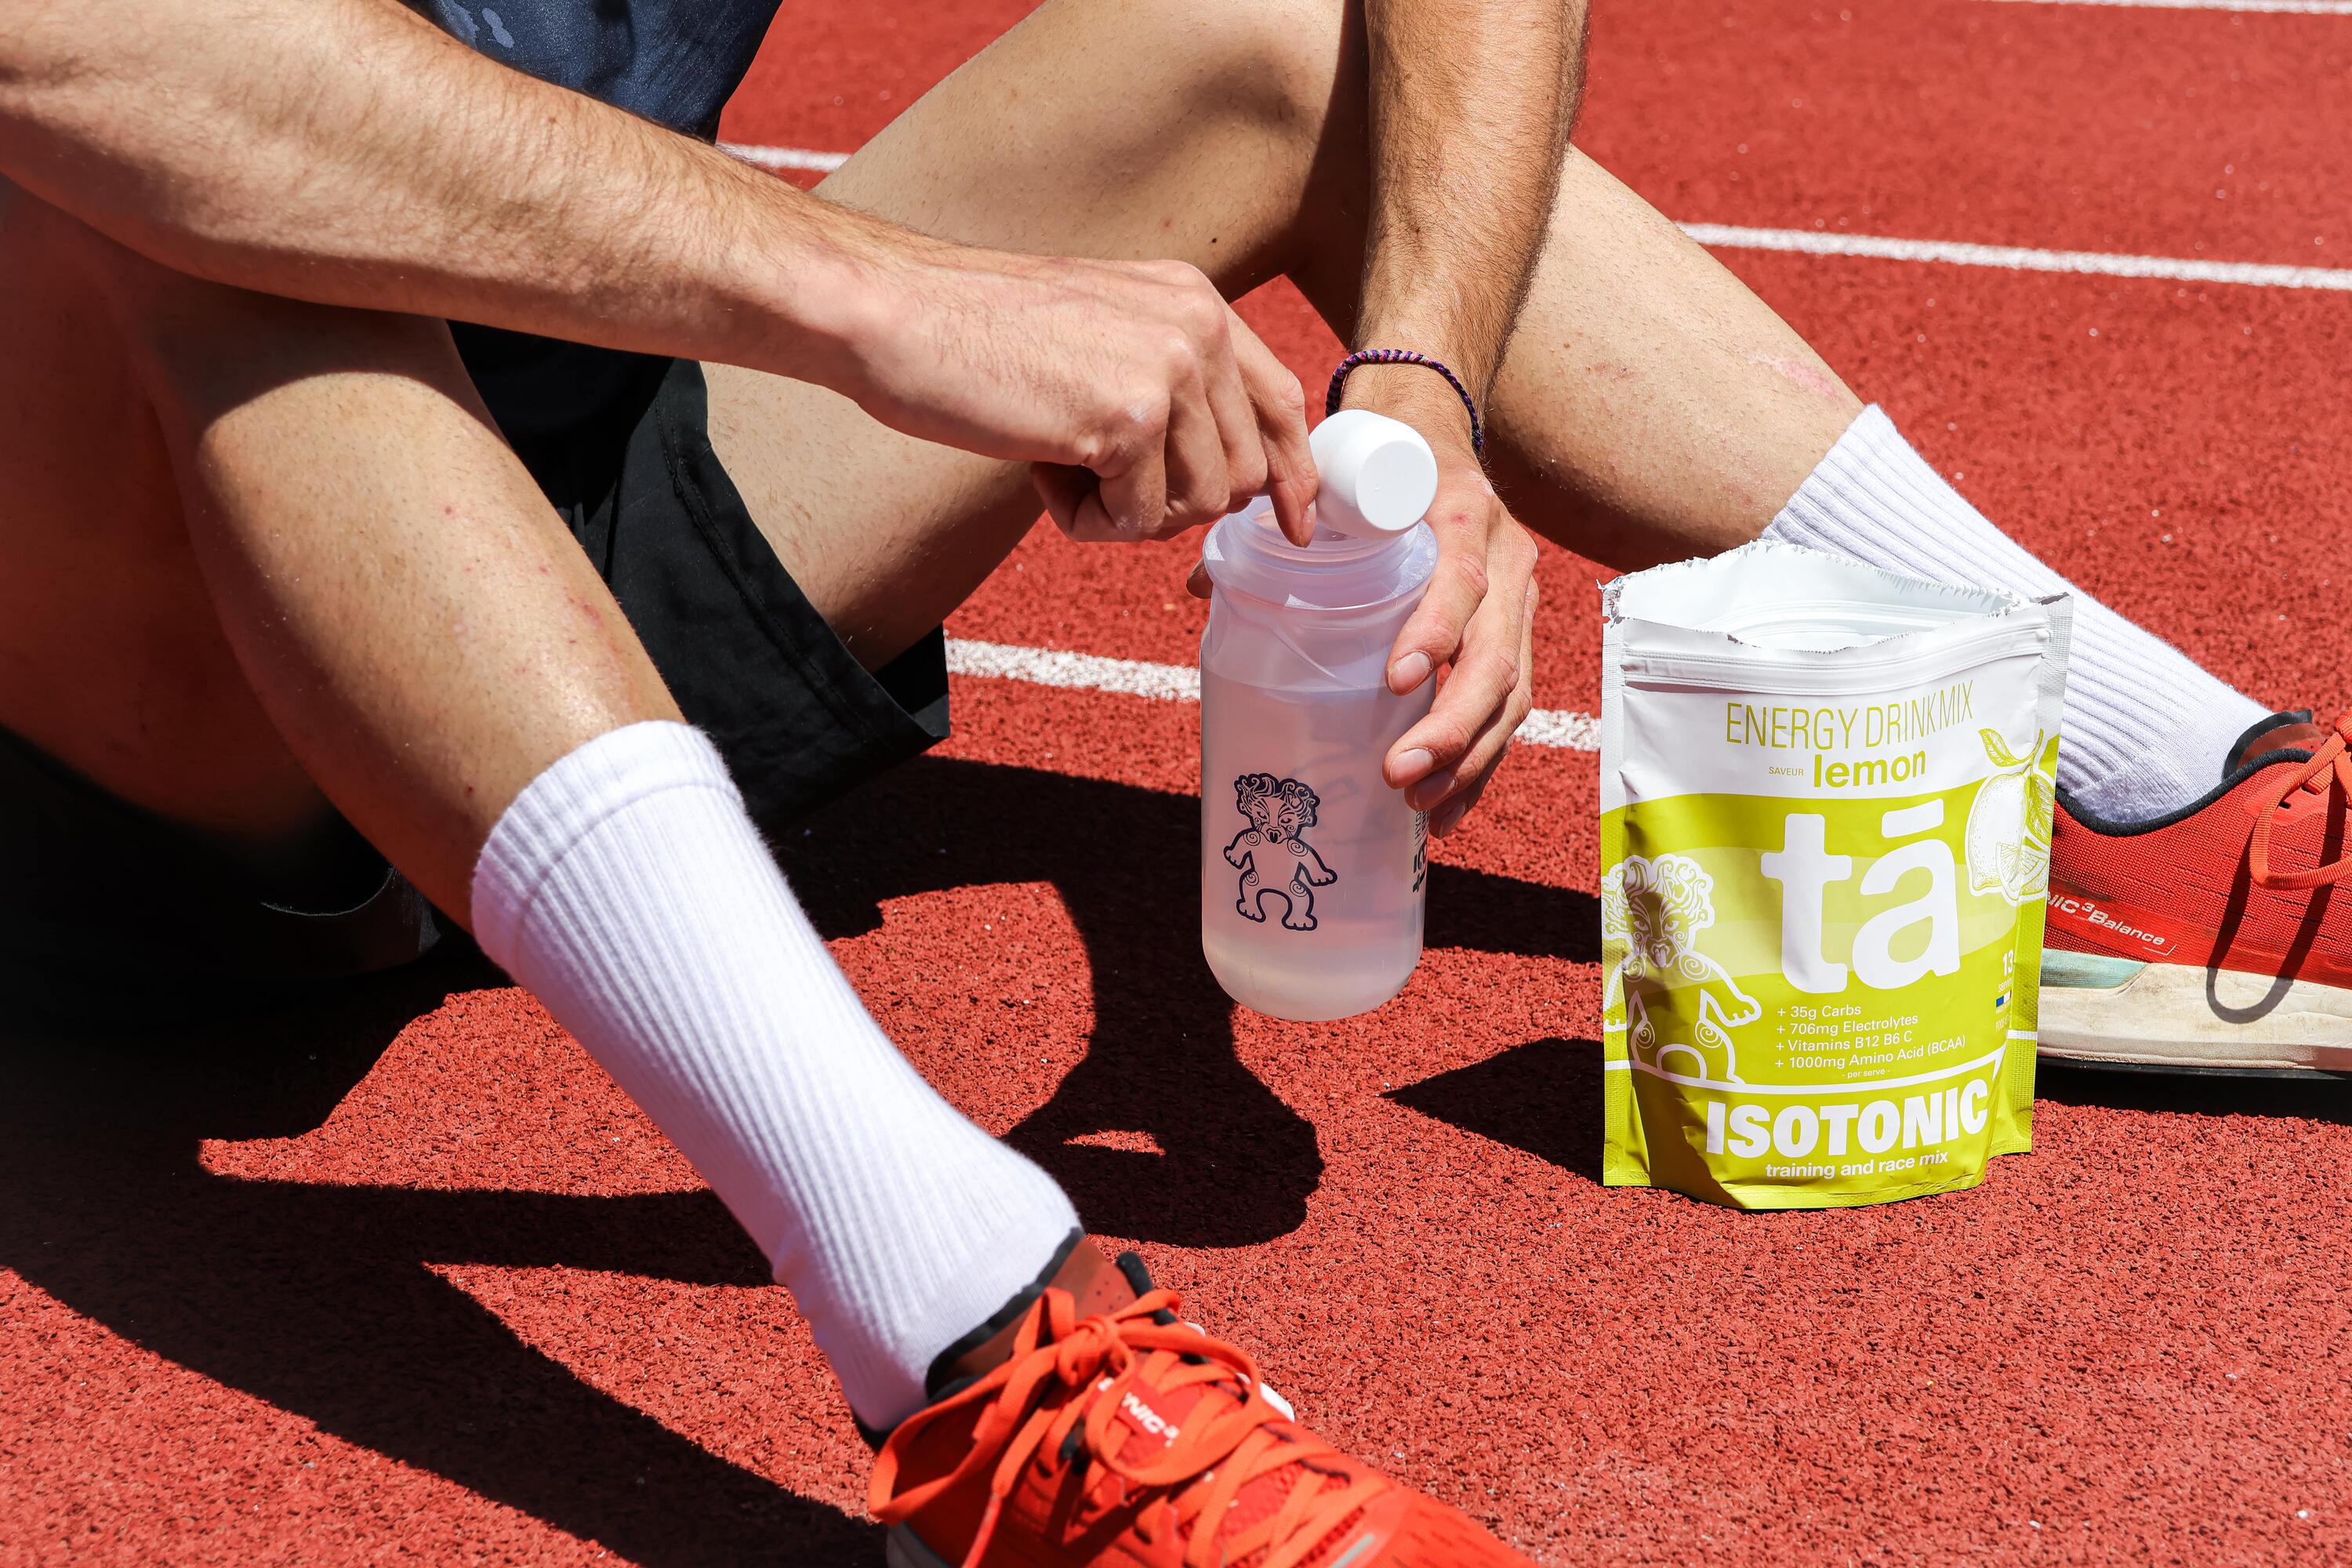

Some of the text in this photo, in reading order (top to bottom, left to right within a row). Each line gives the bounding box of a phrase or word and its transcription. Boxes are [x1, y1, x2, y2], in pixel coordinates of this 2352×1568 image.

[1726, 702, 1859, 750] ENERGY
[1769, 750, 1926, 788] SAVEUR lemon
[1760, 797, 1961, 994] tā
[1790, 1006, 1817, 1021] 35g
[1821, 1004, 1862, 1018] Carbs
[1790, 1022, 1838, 1036] 706mg
[1842, 1014, 1918, 1033] Electrolytes
[1788, 1038, 1851, 1052] Vitamins
[1855, 1035, 1880, 1049] B12
[1884, 1032, 1900, 1046] B6
[1904, 1029, 1913, 1043] C
[1788, 1055, 1846, 1070] 1000mg
[1849, 1051, 1894, 1067] Amino
[1896, 1045, 1925, 1061] Acid
[1926, 1034, 1965, 1057] (BCAA)
[1863, 1068, 1886, 1076] serve
[1706, 1078, 1988, 1159] ISOTONIC
[1766, 1149, 1949, 1179] training and race mix
